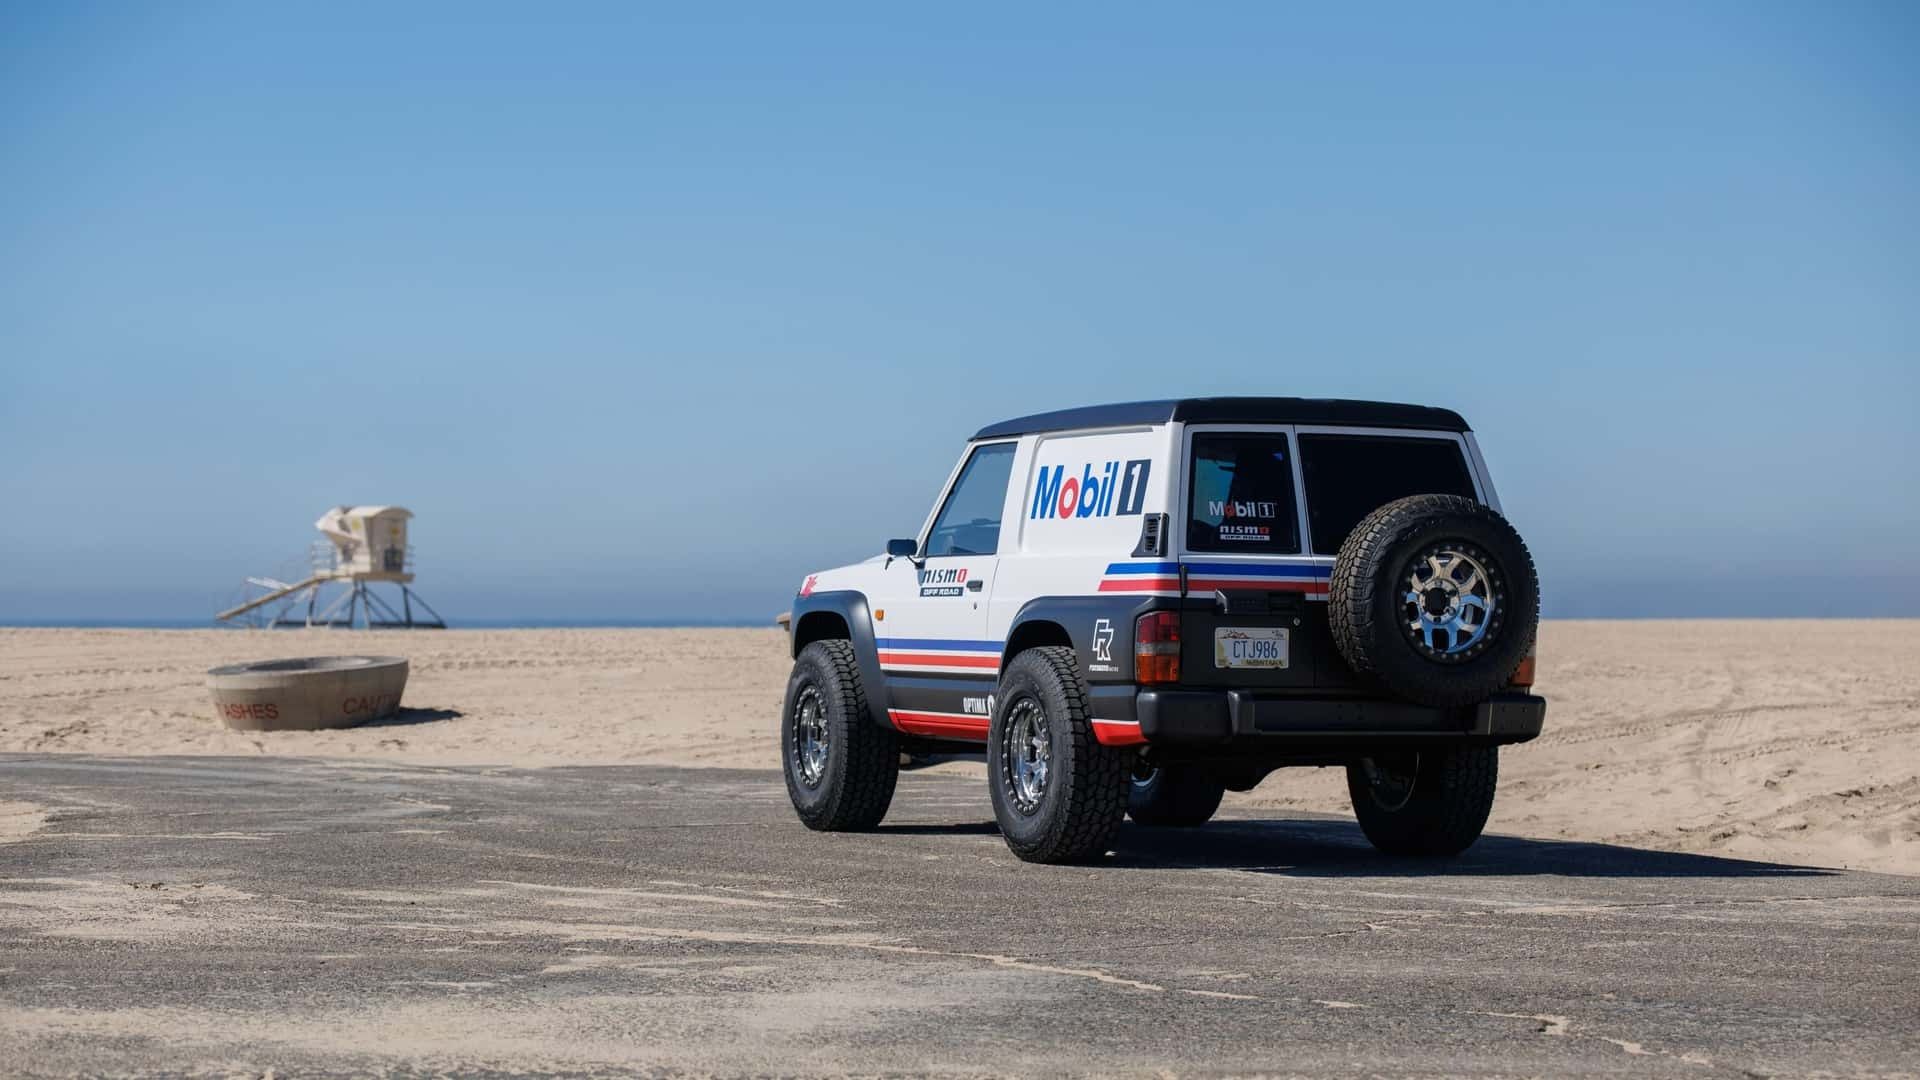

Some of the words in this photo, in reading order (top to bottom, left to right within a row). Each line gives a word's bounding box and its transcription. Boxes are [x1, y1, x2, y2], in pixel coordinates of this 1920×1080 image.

[1030, 461, 1119, 519] Mobil
[1209, 501, 1256, 517] Mobil
[1233, 640, 1278, 659] CTJ986
